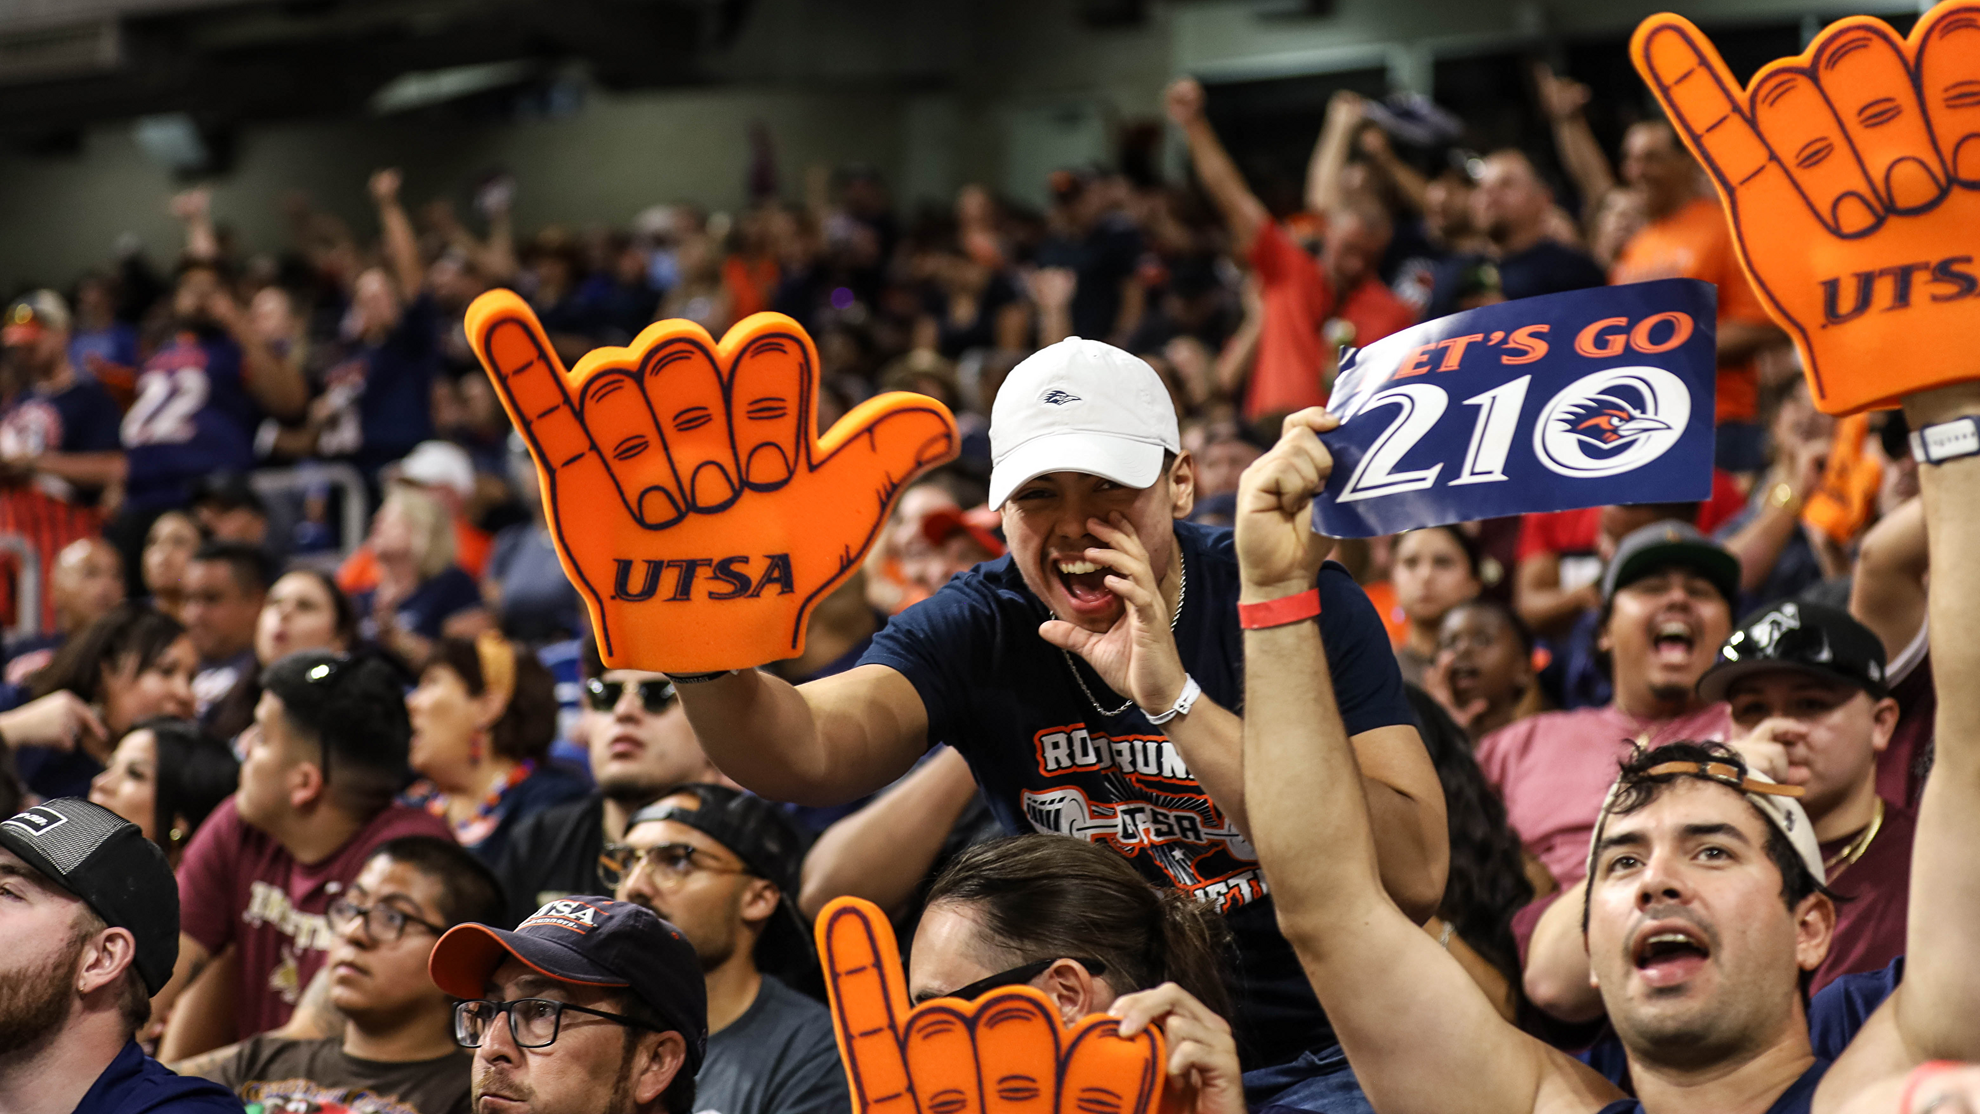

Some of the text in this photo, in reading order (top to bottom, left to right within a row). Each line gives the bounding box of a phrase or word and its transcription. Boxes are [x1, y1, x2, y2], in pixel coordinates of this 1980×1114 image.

[1819, 255, 1980, 329] UTS
[1356, 311, 1694, 391] ET'S GO
[1336, 365, 1691, 503] 210
[610, 553, 795, 602] UTSA
